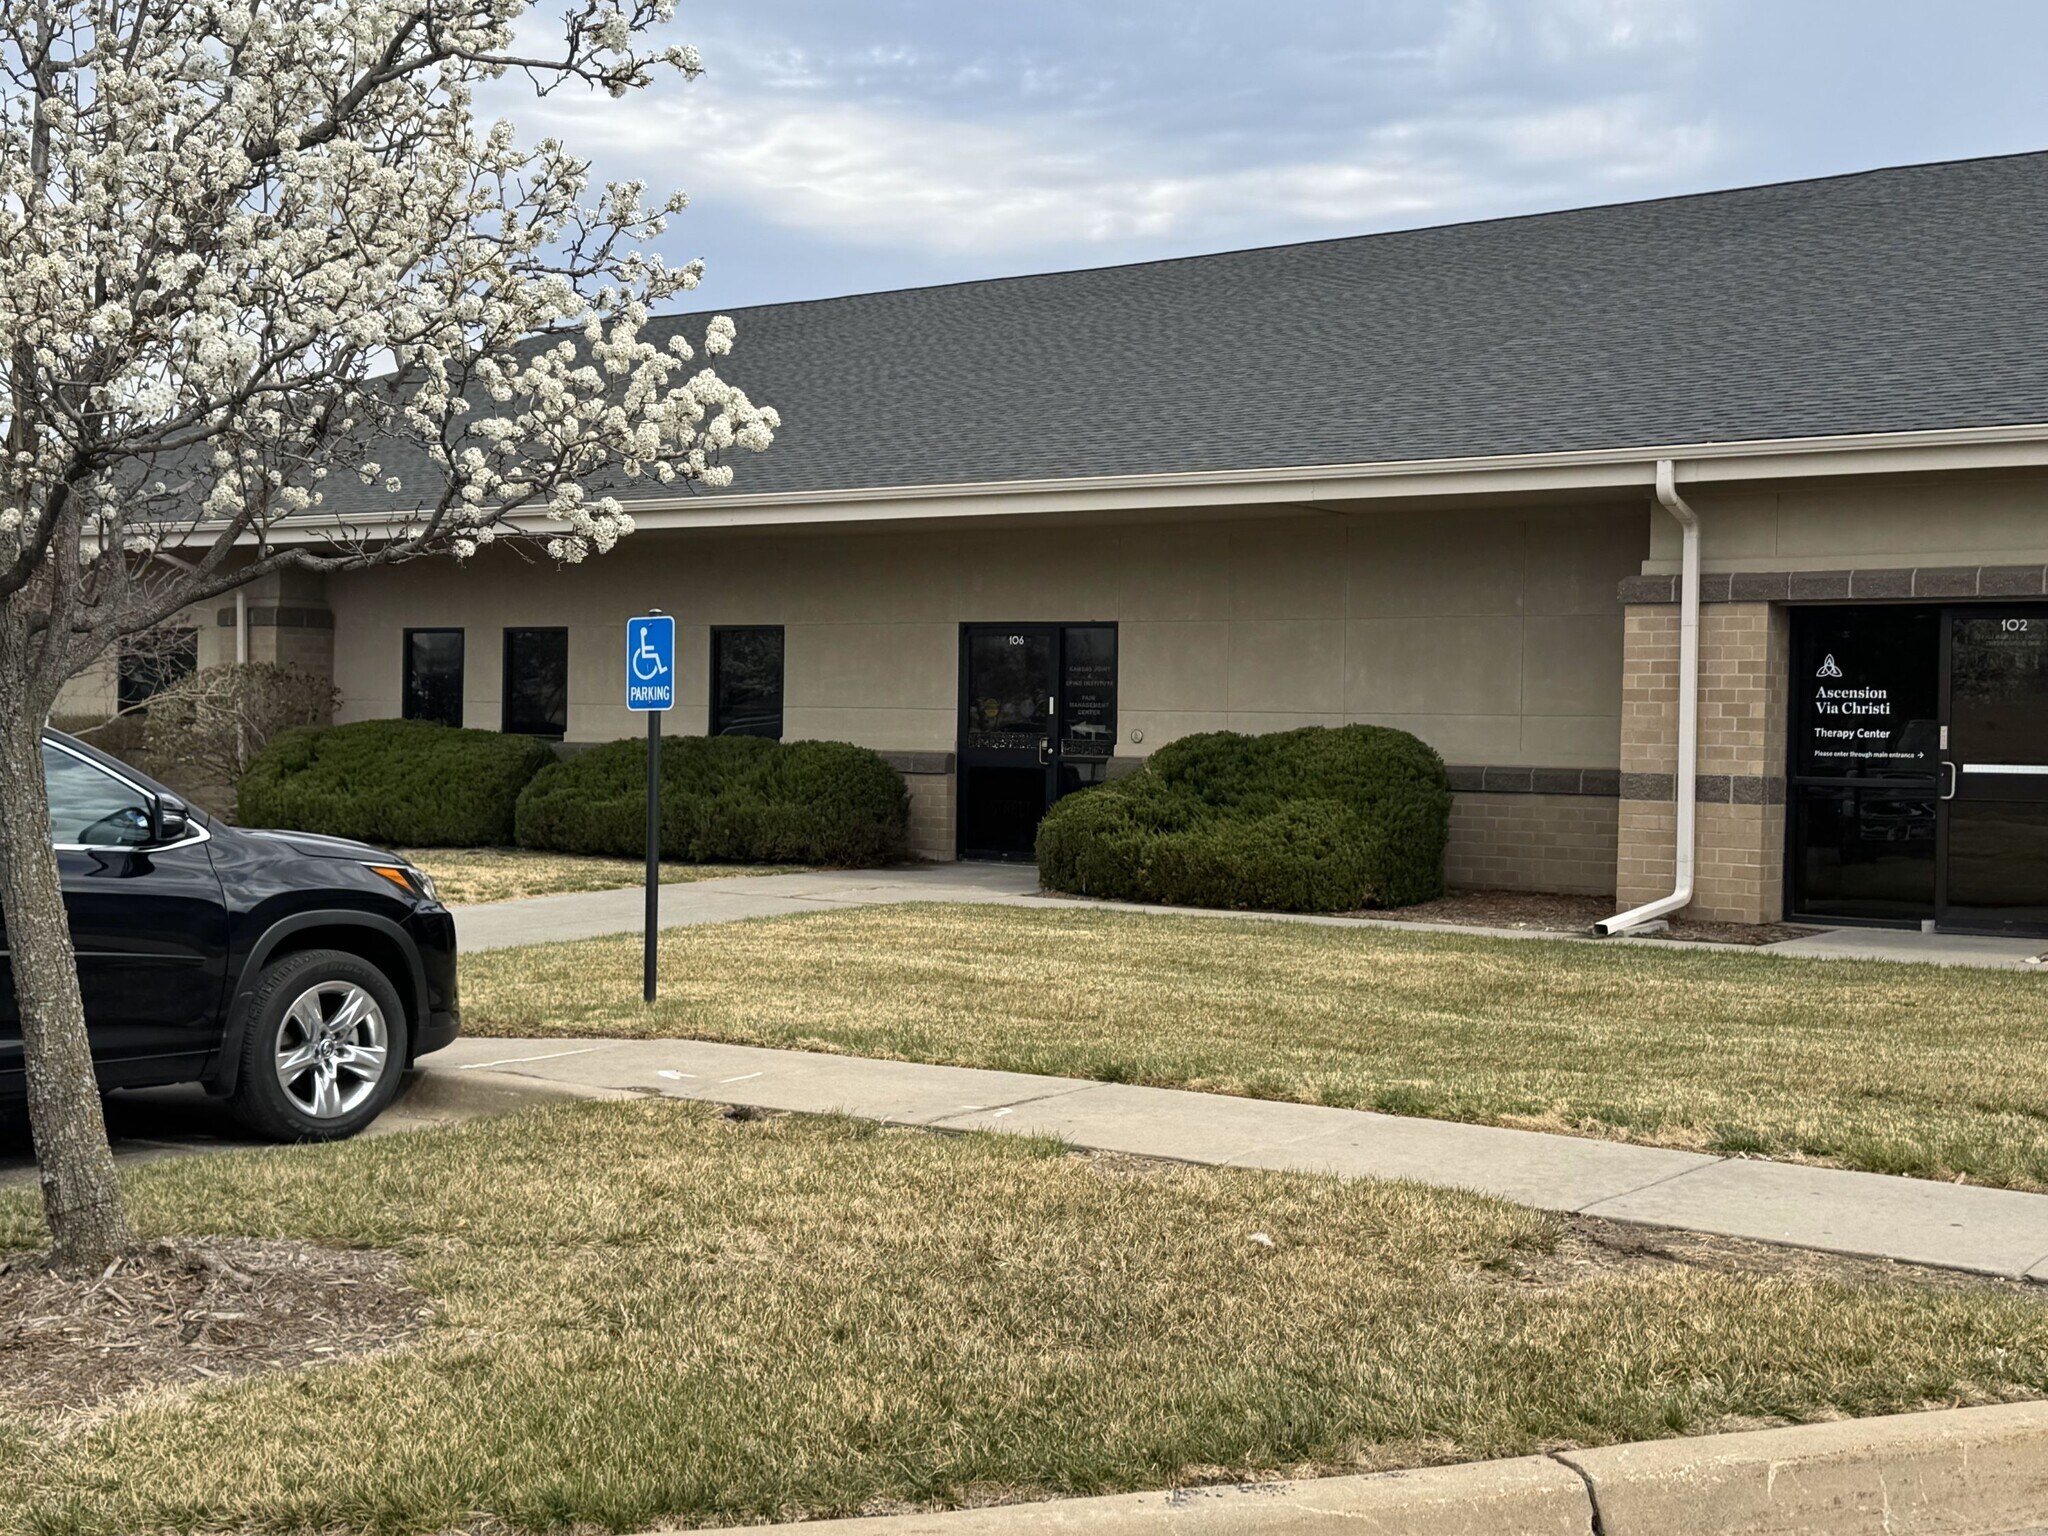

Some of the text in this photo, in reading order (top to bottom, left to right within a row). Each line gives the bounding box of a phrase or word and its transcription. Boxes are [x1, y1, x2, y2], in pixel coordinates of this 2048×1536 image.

[2001, 618, 2028, 632] 102
[1009, 635, 1024, 645] 106
[630, 686, 670, 701] PARKING
[1815, 685, 1887, 699] Ascension
[1815, 701, 1890, 715] Via Christi
[1814, 728, 1891, 740] Therapy Center
[1849, 751, 1873, 759] through
